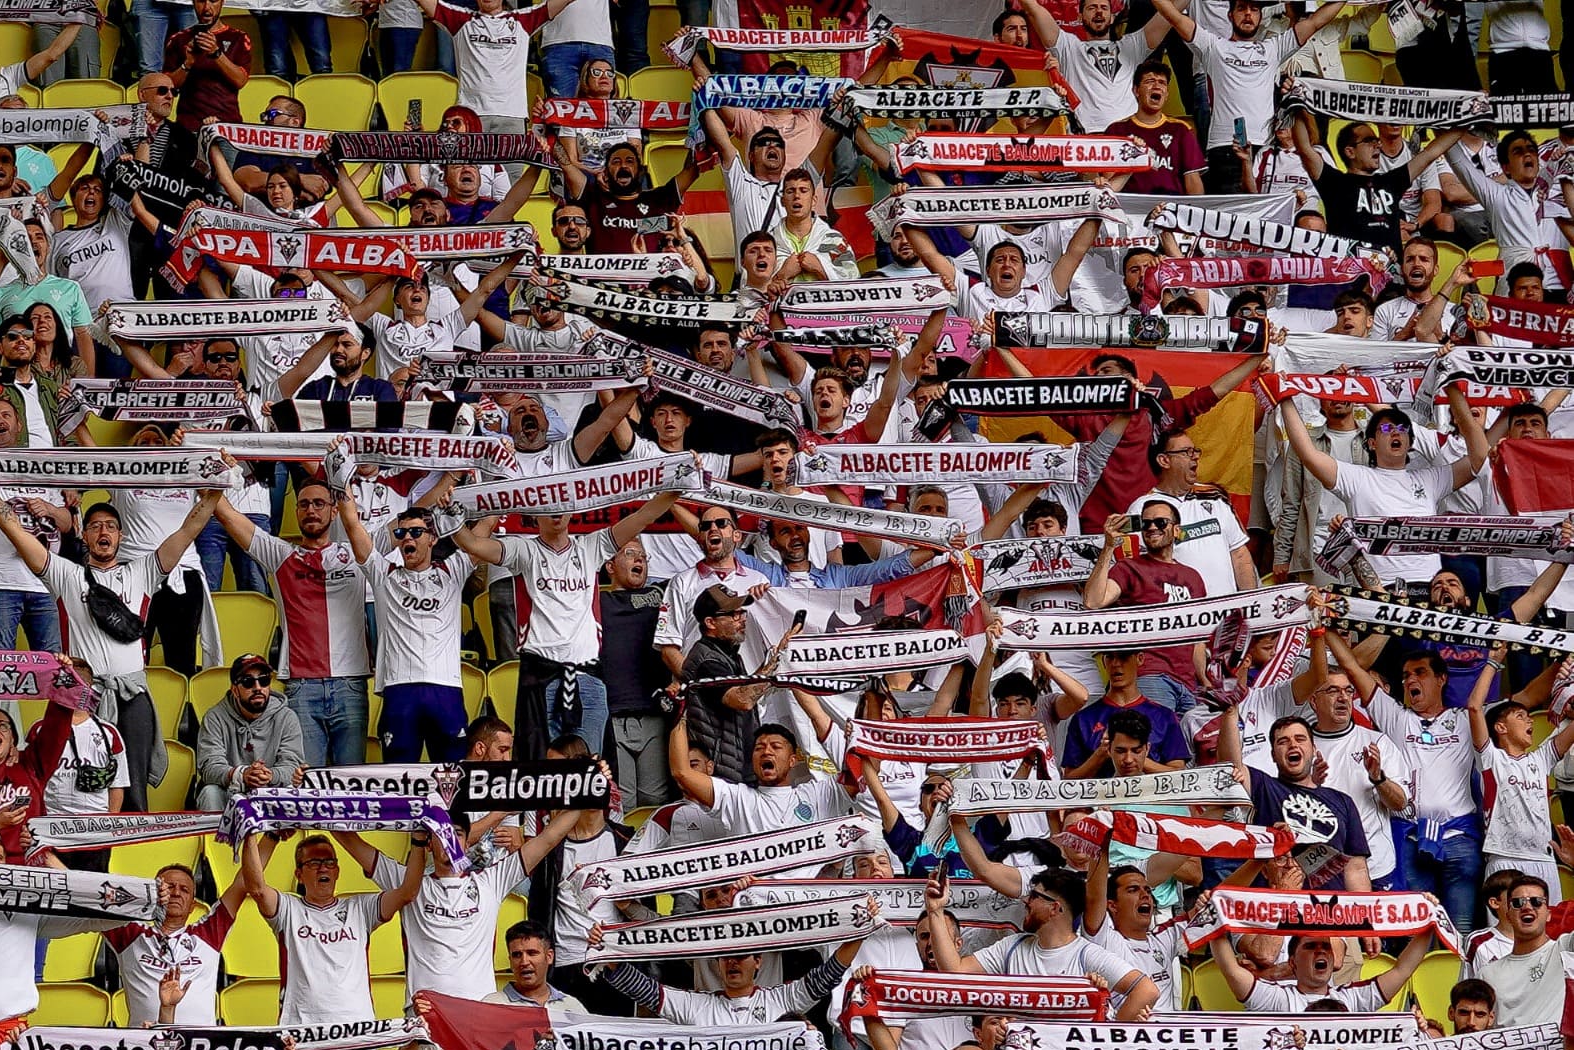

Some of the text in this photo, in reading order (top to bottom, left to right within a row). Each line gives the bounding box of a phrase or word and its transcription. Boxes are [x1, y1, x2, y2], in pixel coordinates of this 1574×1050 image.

[876, 89, 984, 107] ALBACETE
[1313, 90, 1383, 114] ALBACETE
[933, 140, 1001, 161] ALBACETE
[914, 196, 1002, 212] ALBACETE
[1156, 203, 1350, 259] SQUADRA
[181, 230, 406, 270] AUPA ALBA
[135, 309, 221, 326] ALBACETE
[1030, 314, 1230, 349] YOUTH ABP
[949, 385, 1036, 406] ALBACETE
[840, 449, 934, 473] ALBACETE
[475, 481, 568, 512] ALBACETE
[1050, 619, 1152, 636] ALBACETE
[1375, 606, 1501, 635] ALBACETE
[1463, 639, 1487, 647] ALBA
[31, 655, 48, 664] Y...
[621, 854, 723, 883] ALBACETE
[617, 919, 727, 945] ALBACETE
[885, 986, 1089, 1008] LOCURA POR EL ALBA
[1066, 1027, 1239, 1043] ALBACETE
